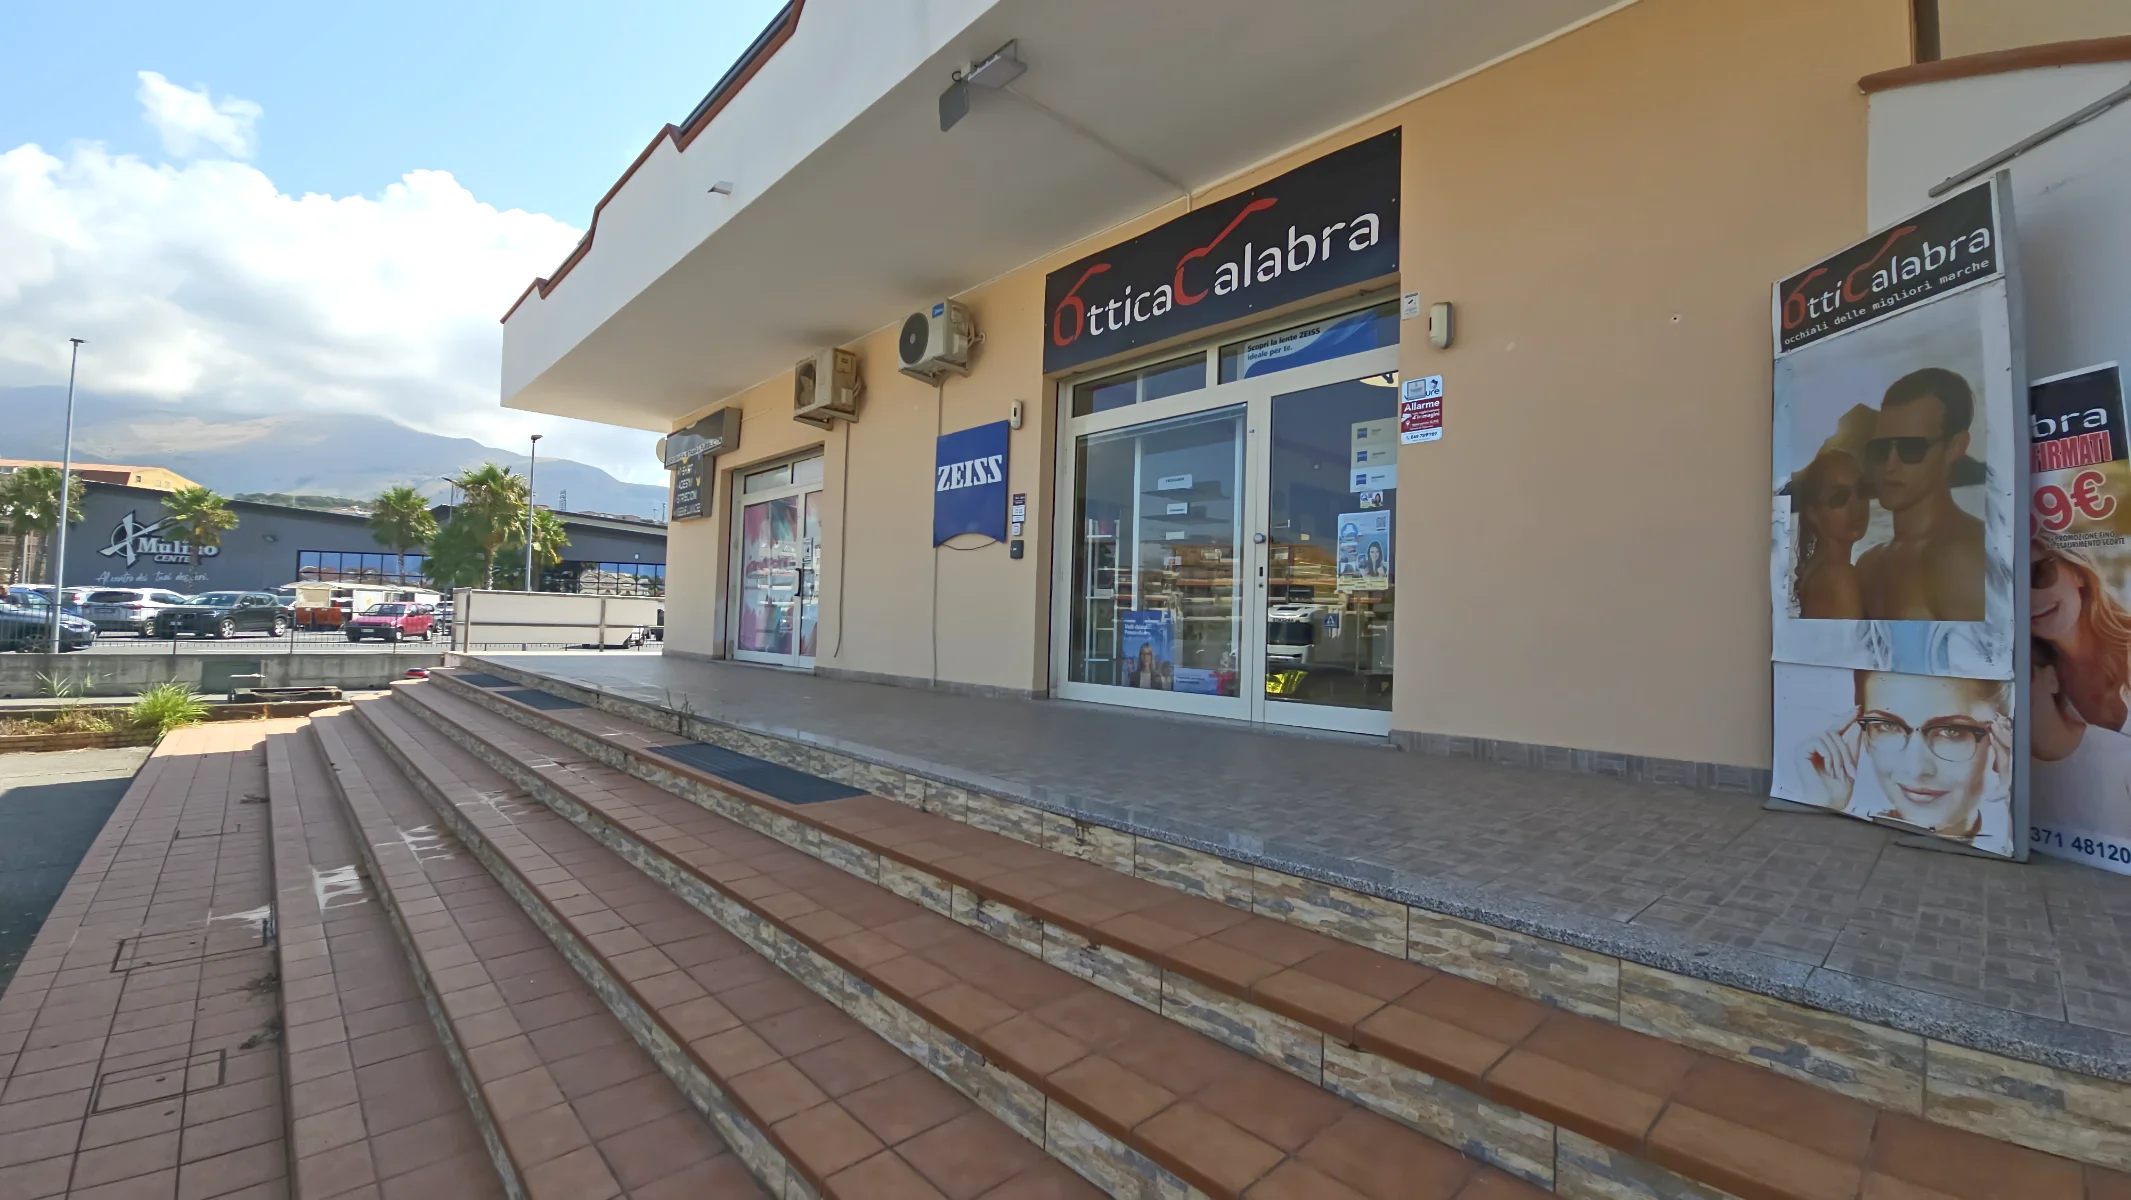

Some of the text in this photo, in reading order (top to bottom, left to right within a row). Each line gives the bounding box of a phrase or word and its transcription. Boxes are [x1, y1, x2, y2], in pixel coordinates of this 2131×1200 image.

[1784, 259, 1990, 345] occhiali delle migliori marche
[1247, 327, 1321, 353] Scopri la lente ZEISS
[1247, 344, 1293, 361] ideale per te.
[1404, 400, 1440, 412] Allarme
[936, 454, 1003, 492] ZEISS
[2055, 531, 2115, 542] PROMOZIONE FINO
[2102, 538, 2126, 546] SCORTE
[137, 537, 219, 555] Mulio
[154, 555, 191, 563] CENTE
[111, 573, 134, 583] centro
[2030, 826, 2131, 865] 371 48120
